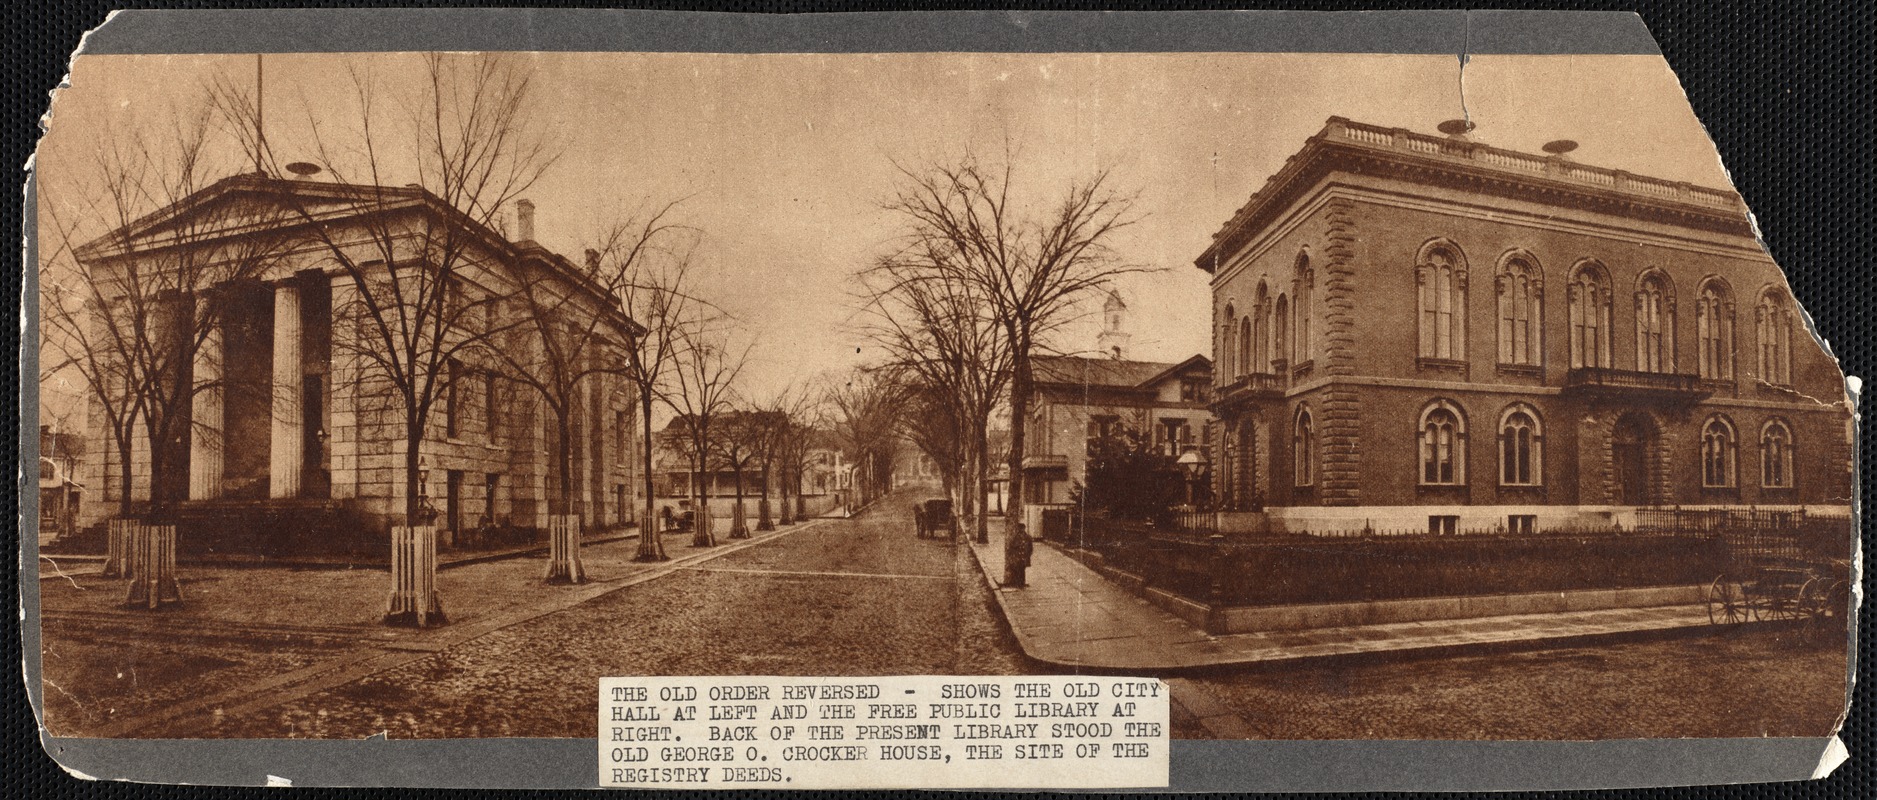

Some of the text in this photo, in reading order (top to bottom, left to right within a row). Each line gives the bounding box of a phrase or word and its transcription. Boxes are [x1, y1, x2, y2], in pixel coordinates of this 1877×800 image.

[612, 686, 648, 701] THE
[660, 686, 697, 701] OLD
[709, 685, 771, 701] ORDER
[782, 684, 880, 700] REVERSED
[941, 683, 1001, 699] SHOWS
[1014, 683, 1051, 699] THE
[1063, 682, 1100, 698] OLD
[1111, 682, 1160, 698] CITY
[611, 702, 1136, 721] HALL AT LEFT AND THE FREE PUBLIC LIBRARY AT
[611, 722, 1161, 742] RIGHT. BACK OF THE PRESENT LIBRARY STOOD THE
[611, 743, 1149, 764] OLD GEORGE O. CROCKER HOUSE, THE SITE OF THE
[611, 767, 793, 783] REGISTRY DEEDS.
